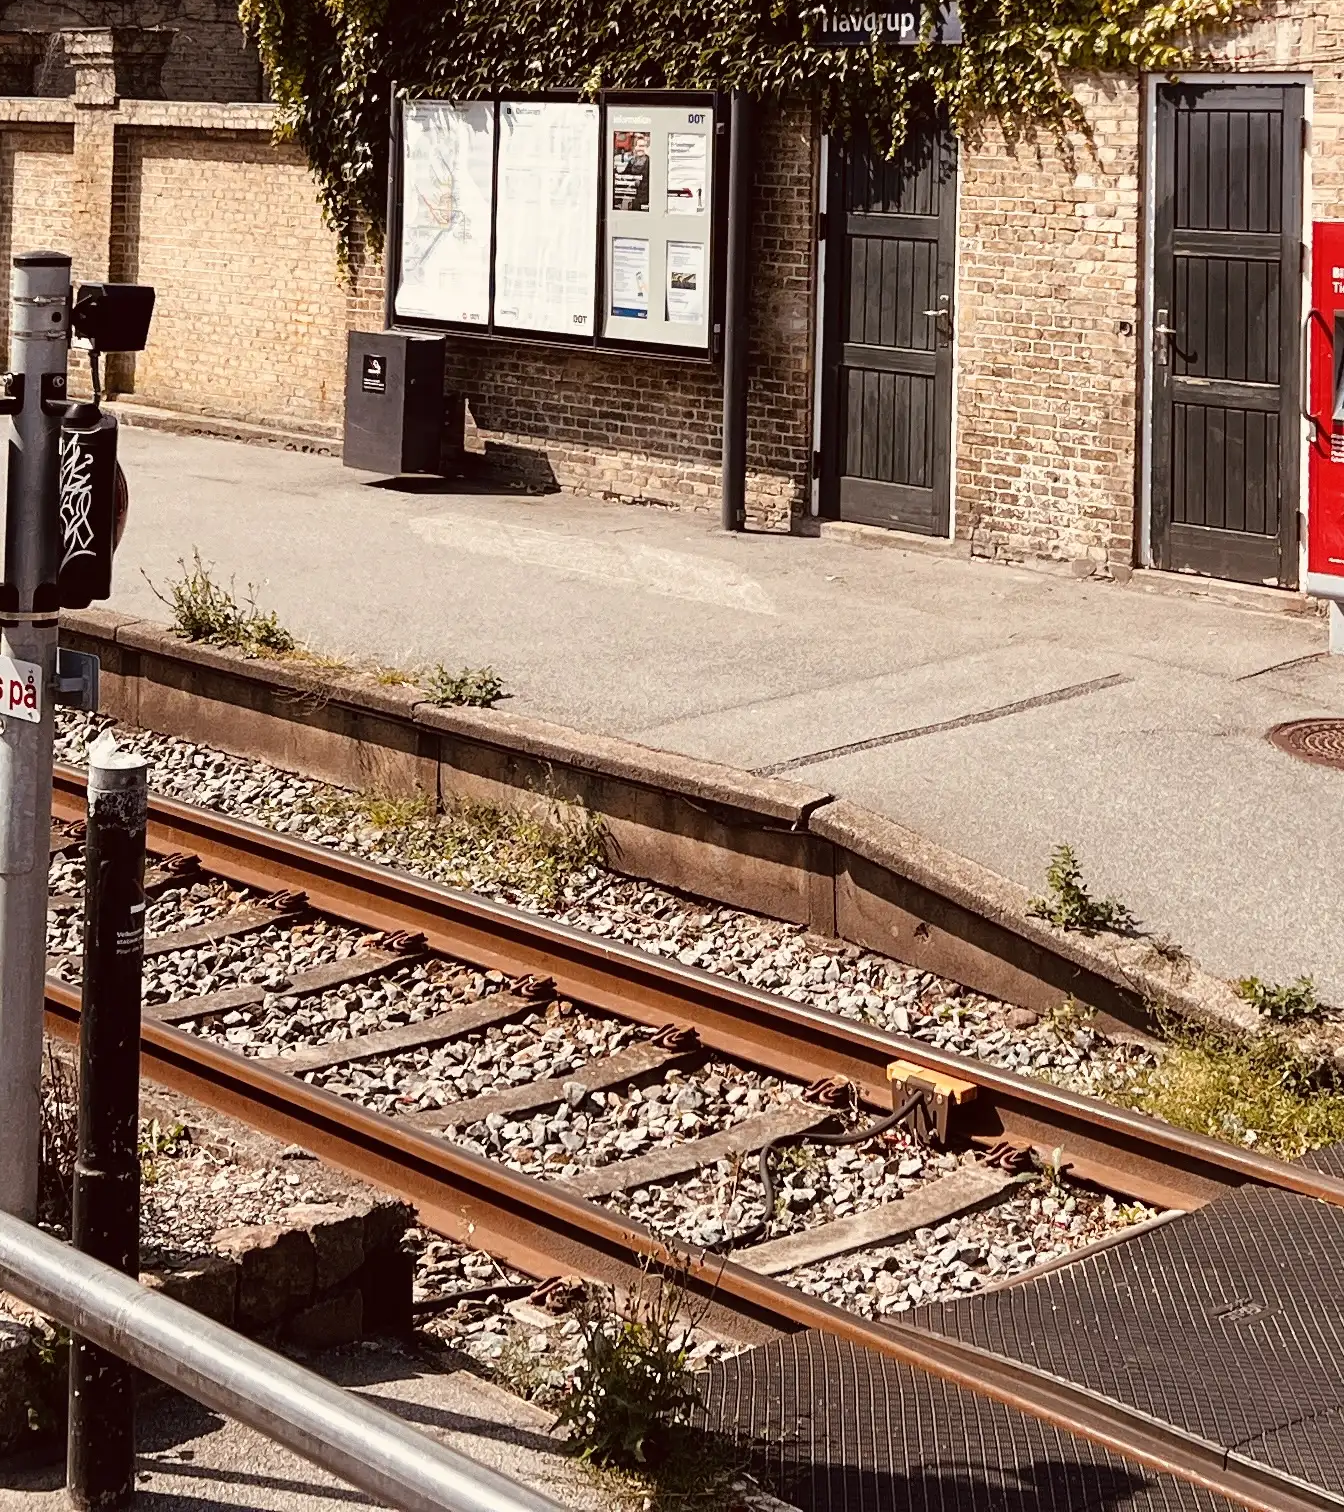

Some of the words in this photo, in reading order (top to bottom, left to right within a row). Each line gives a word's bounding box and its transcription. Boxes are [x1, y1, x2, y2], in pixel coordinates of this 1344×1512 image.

[688, 114, 706, 124] DOT
[573, 315, 587, 324] DOT
[9, 676, 37, 711] på
